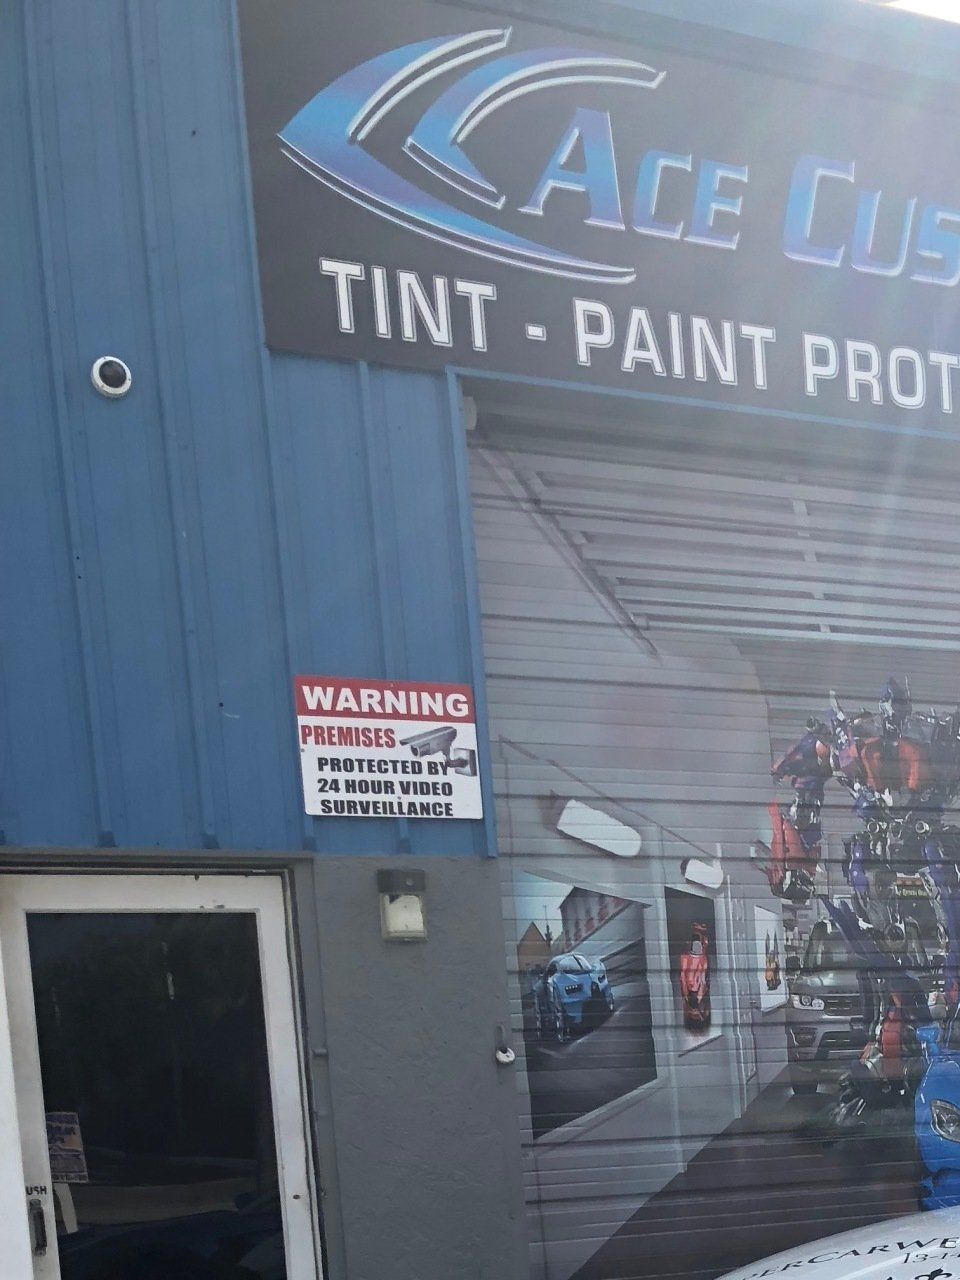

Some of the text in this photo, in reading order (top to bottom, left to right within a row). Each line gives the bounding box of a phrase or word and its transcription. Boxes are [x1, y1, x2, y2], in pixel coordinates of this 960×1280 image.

[517, 106, 749, 250] ACE
[319, 256, 497, 352] TINT
[574, 297, 776, 391] PAINT
[302, 685, 469, 718] WARNING
[300, 724, 396, 749] PREMISES
[317, 757, 449, 776] PROTECTED BY
[317, 778, 453, 797] 24 HOUR VIDEO
[321, 799, 454, 817] SURVEILLANCE
[25, 1185, 47, 1196] USH
